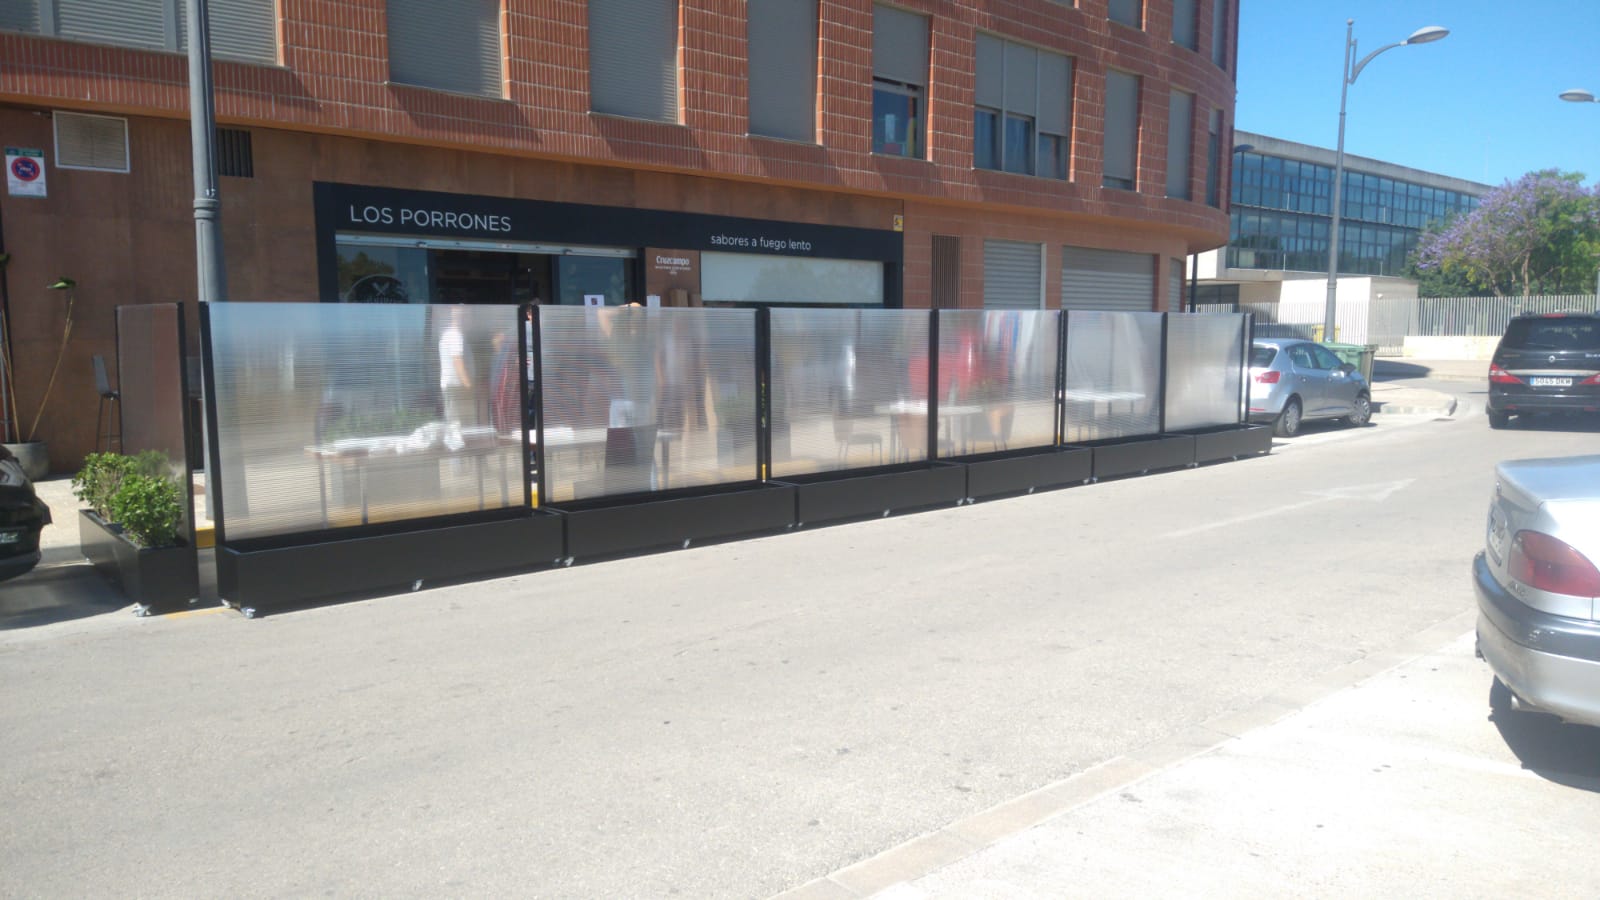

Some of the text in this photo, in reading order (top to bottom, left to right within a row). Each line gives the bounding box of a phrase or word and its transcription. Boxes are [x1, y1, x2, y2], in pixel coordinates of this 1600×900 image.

[350, 205, 512, 232] LOS PORRONES
[711, 233, 811, 251] sabores a fuego lento
[656, 255, 690, 266] Cruzcampo
